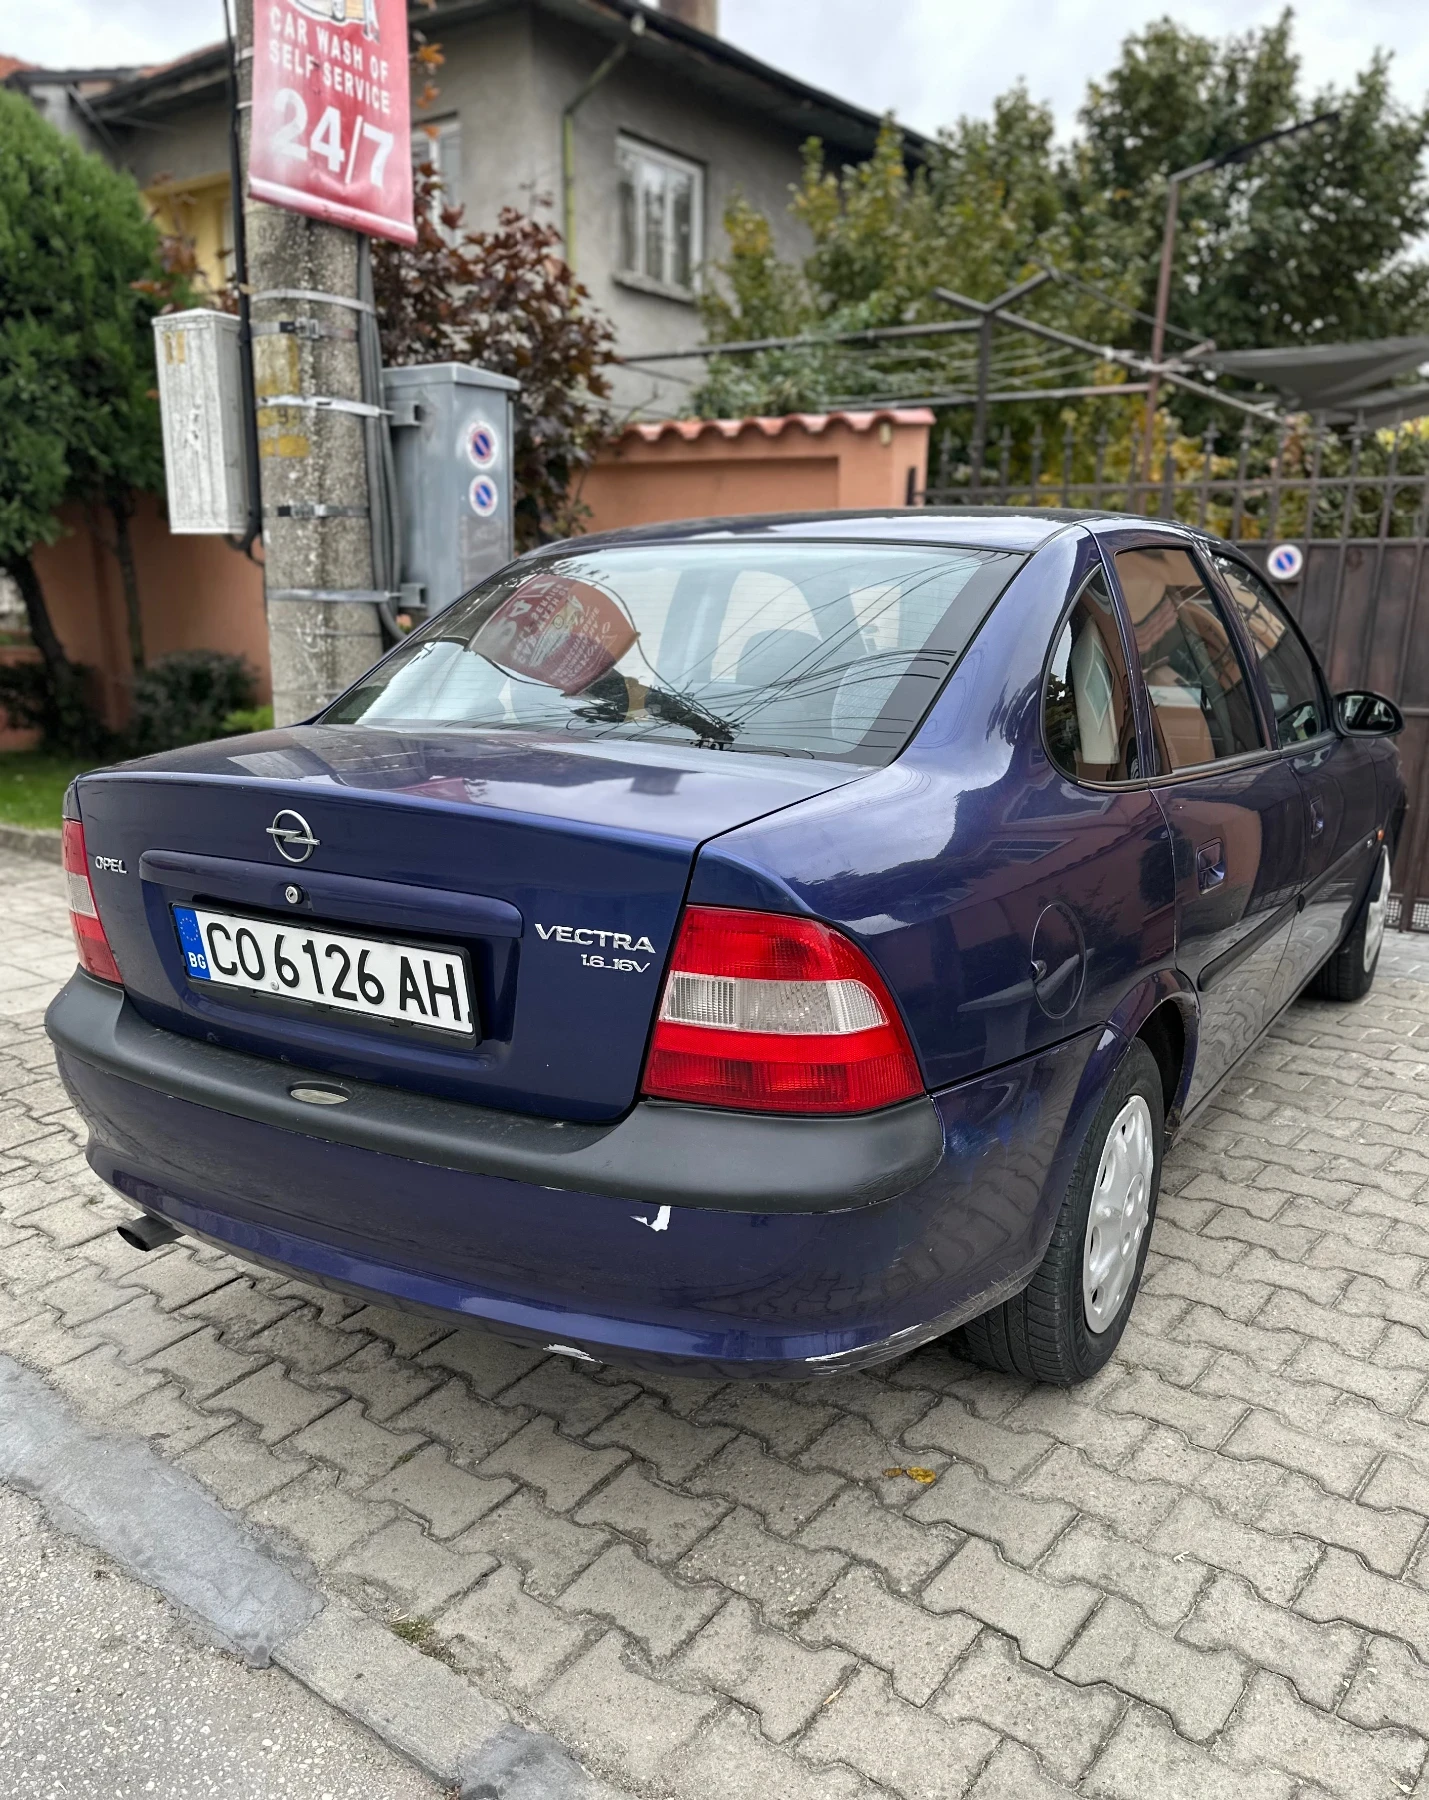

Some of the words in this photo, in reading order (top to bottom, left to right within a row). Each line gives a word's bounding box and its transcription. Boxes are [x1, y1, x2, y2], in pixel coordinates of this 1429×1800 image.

[269, 39, 315, 78] SELF
[322, 63, 390, 114] SERVICE
[270, 7, 308, 45] CAR
[316, 27, 363, 71] WASH
[370, 56, 388, 83] OF
[273, 88, 394, 188] 24/7
[95, 855, 128, 874] OPEL
[188, 952, 207, 970] BG
[206, 923, 266, 981] CO
[274, 934, 385, 1005] 6126
[399, 956, 462, 1022] AH
[535, 924, 656, 953] VECTRA
